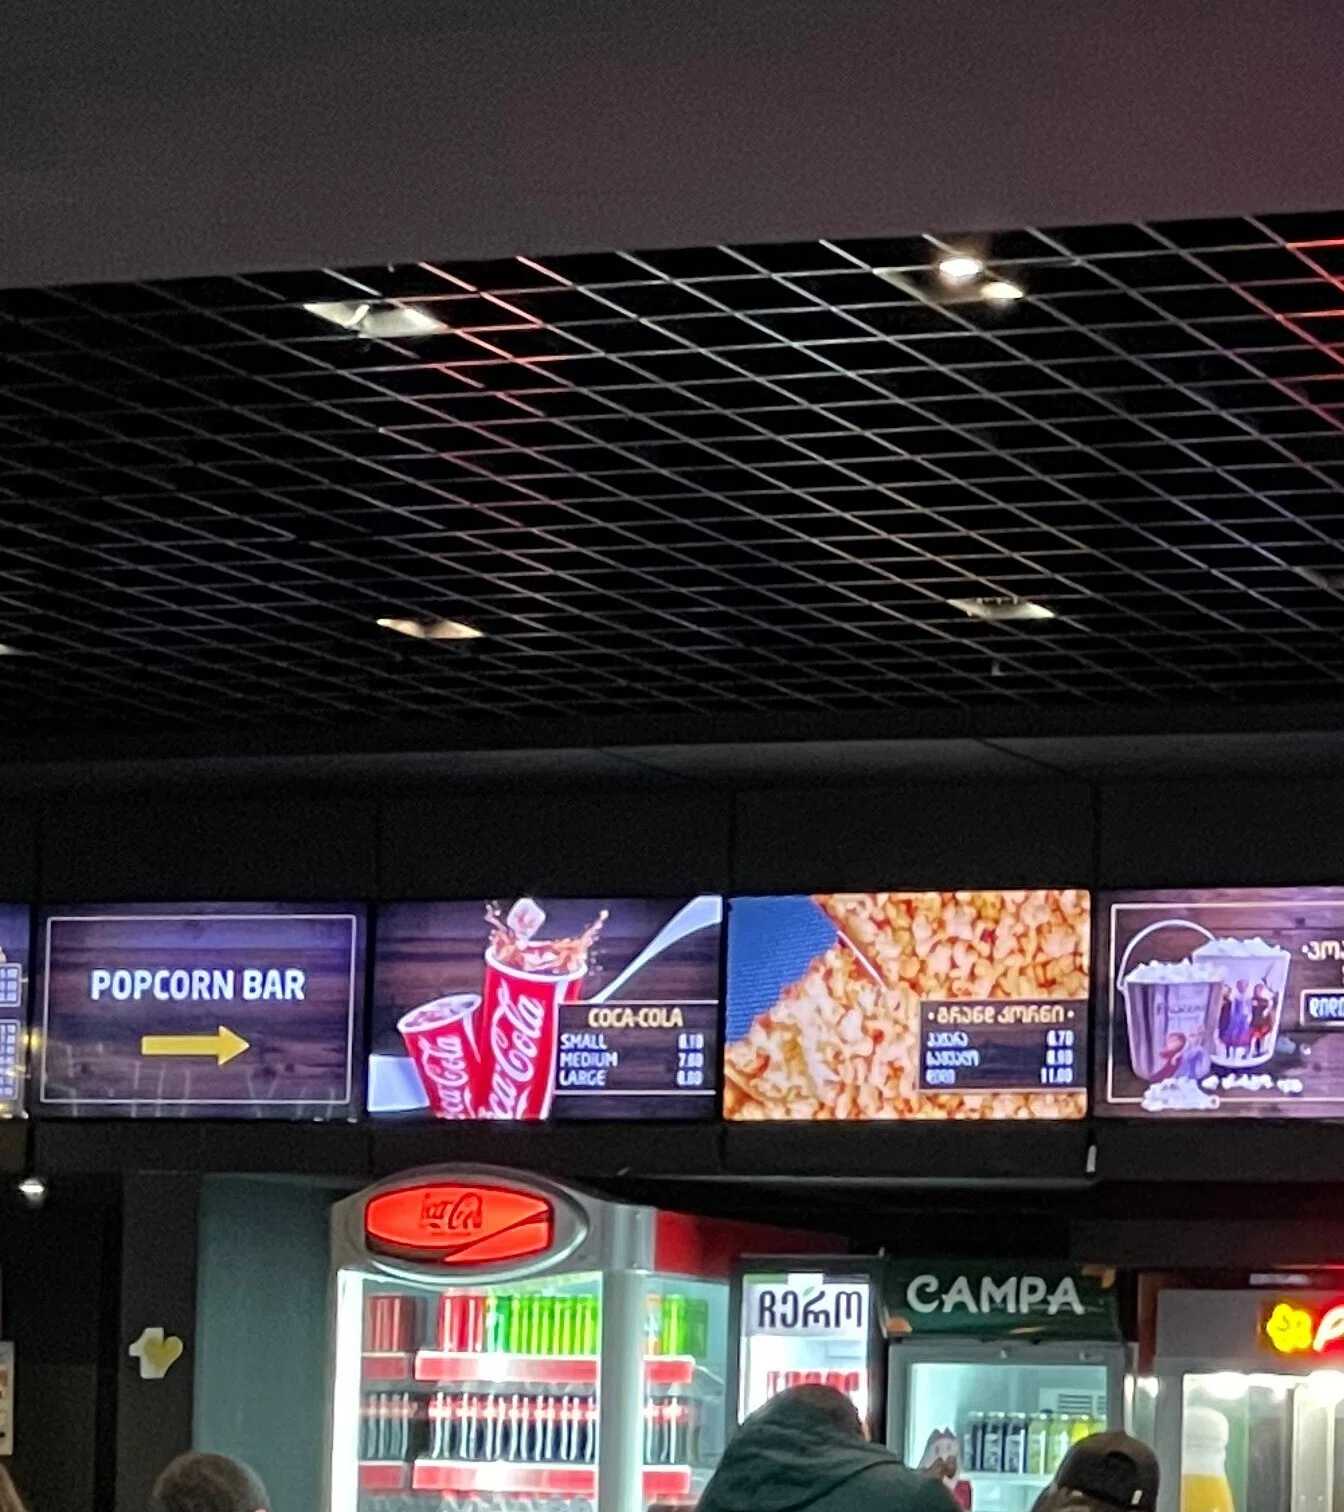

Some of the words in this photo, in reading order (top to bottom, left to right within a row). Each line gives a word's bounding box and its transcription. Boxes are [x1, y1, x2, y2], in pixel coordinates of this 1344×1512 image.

[90, 969, 235, 1001] POPCORN
[242, 969, 306, 1001] BAR
[587, 1007, 684, 1028] COCA-COLA
[560, 1033, 608, 1050] SMALL
[560, 1051, 618, 1067] MEDIUM
[559, 1069, 607, 1086] LARGE
[907, 1274, 1086, 1315] CAMPA
